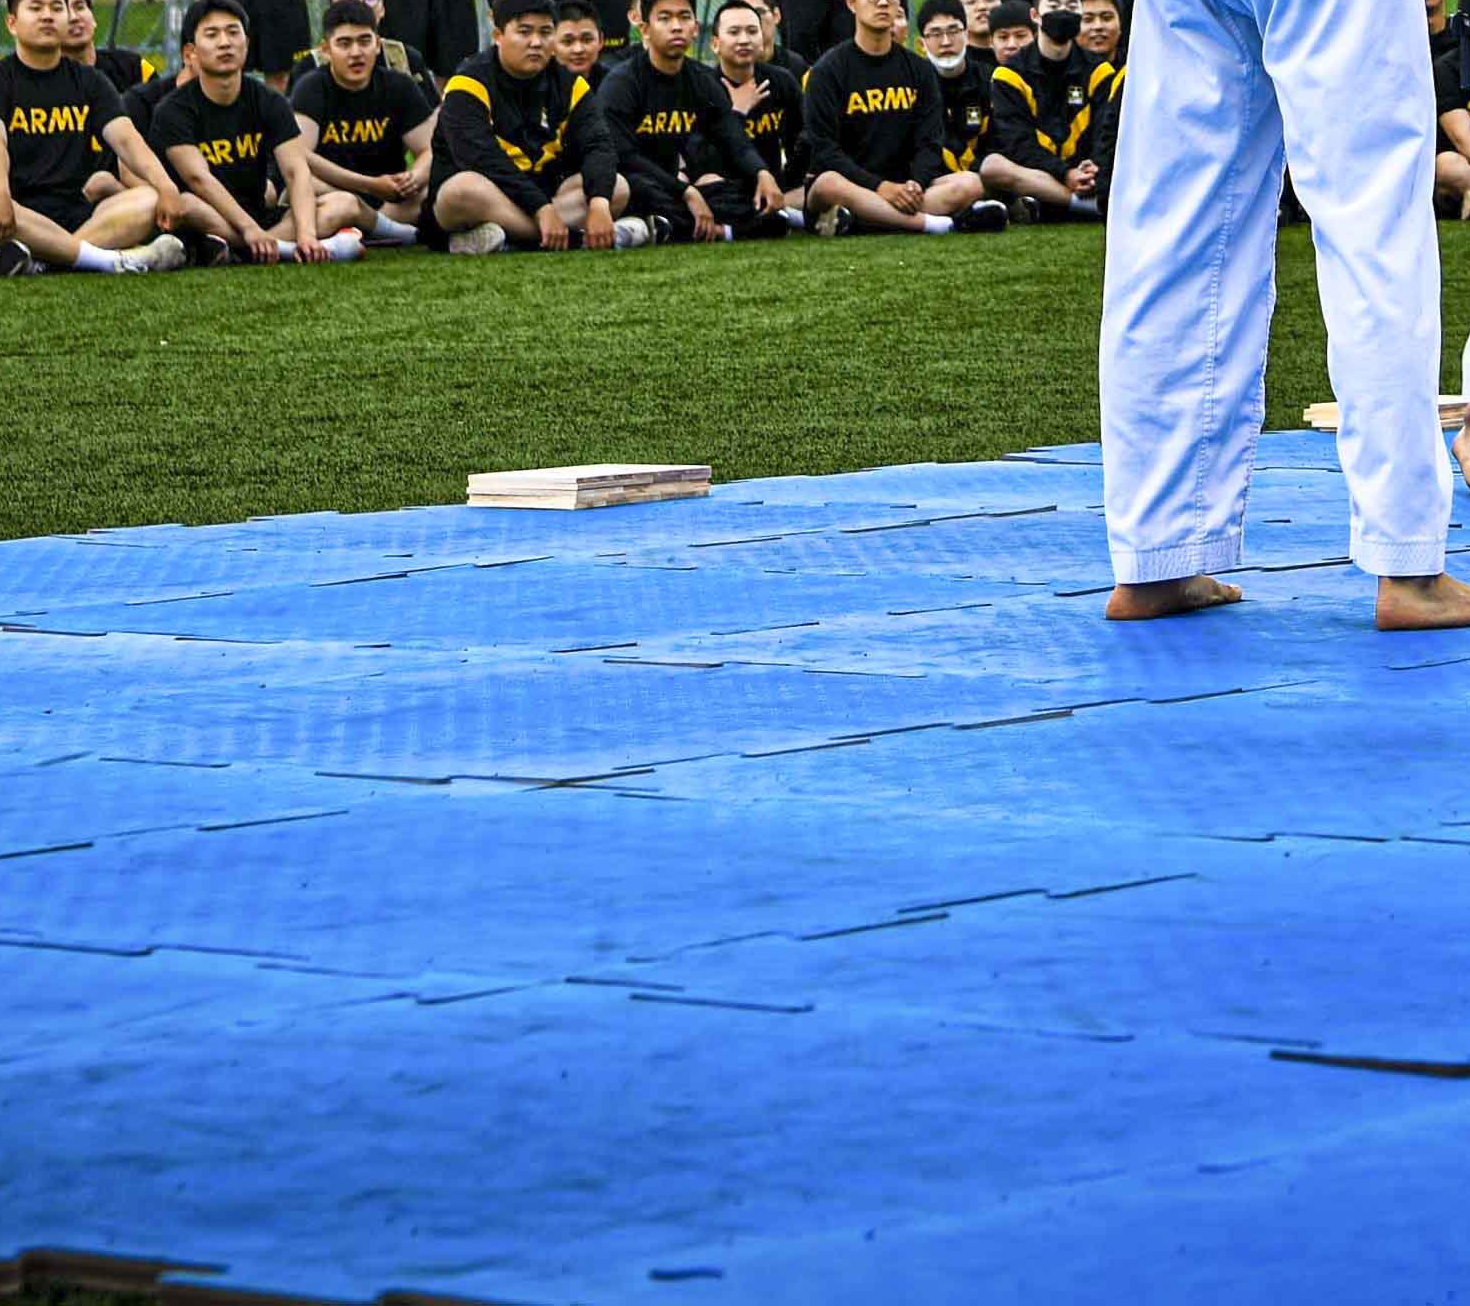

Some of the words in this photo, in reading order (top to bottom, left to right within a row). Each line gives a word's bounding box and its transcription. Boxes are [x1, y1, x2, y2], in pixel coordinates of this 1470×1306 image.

[847, 87, 918, 116] ARMY
[8, 105, 90, 135] ARMY
[745, 112, 786, 137] RMY
